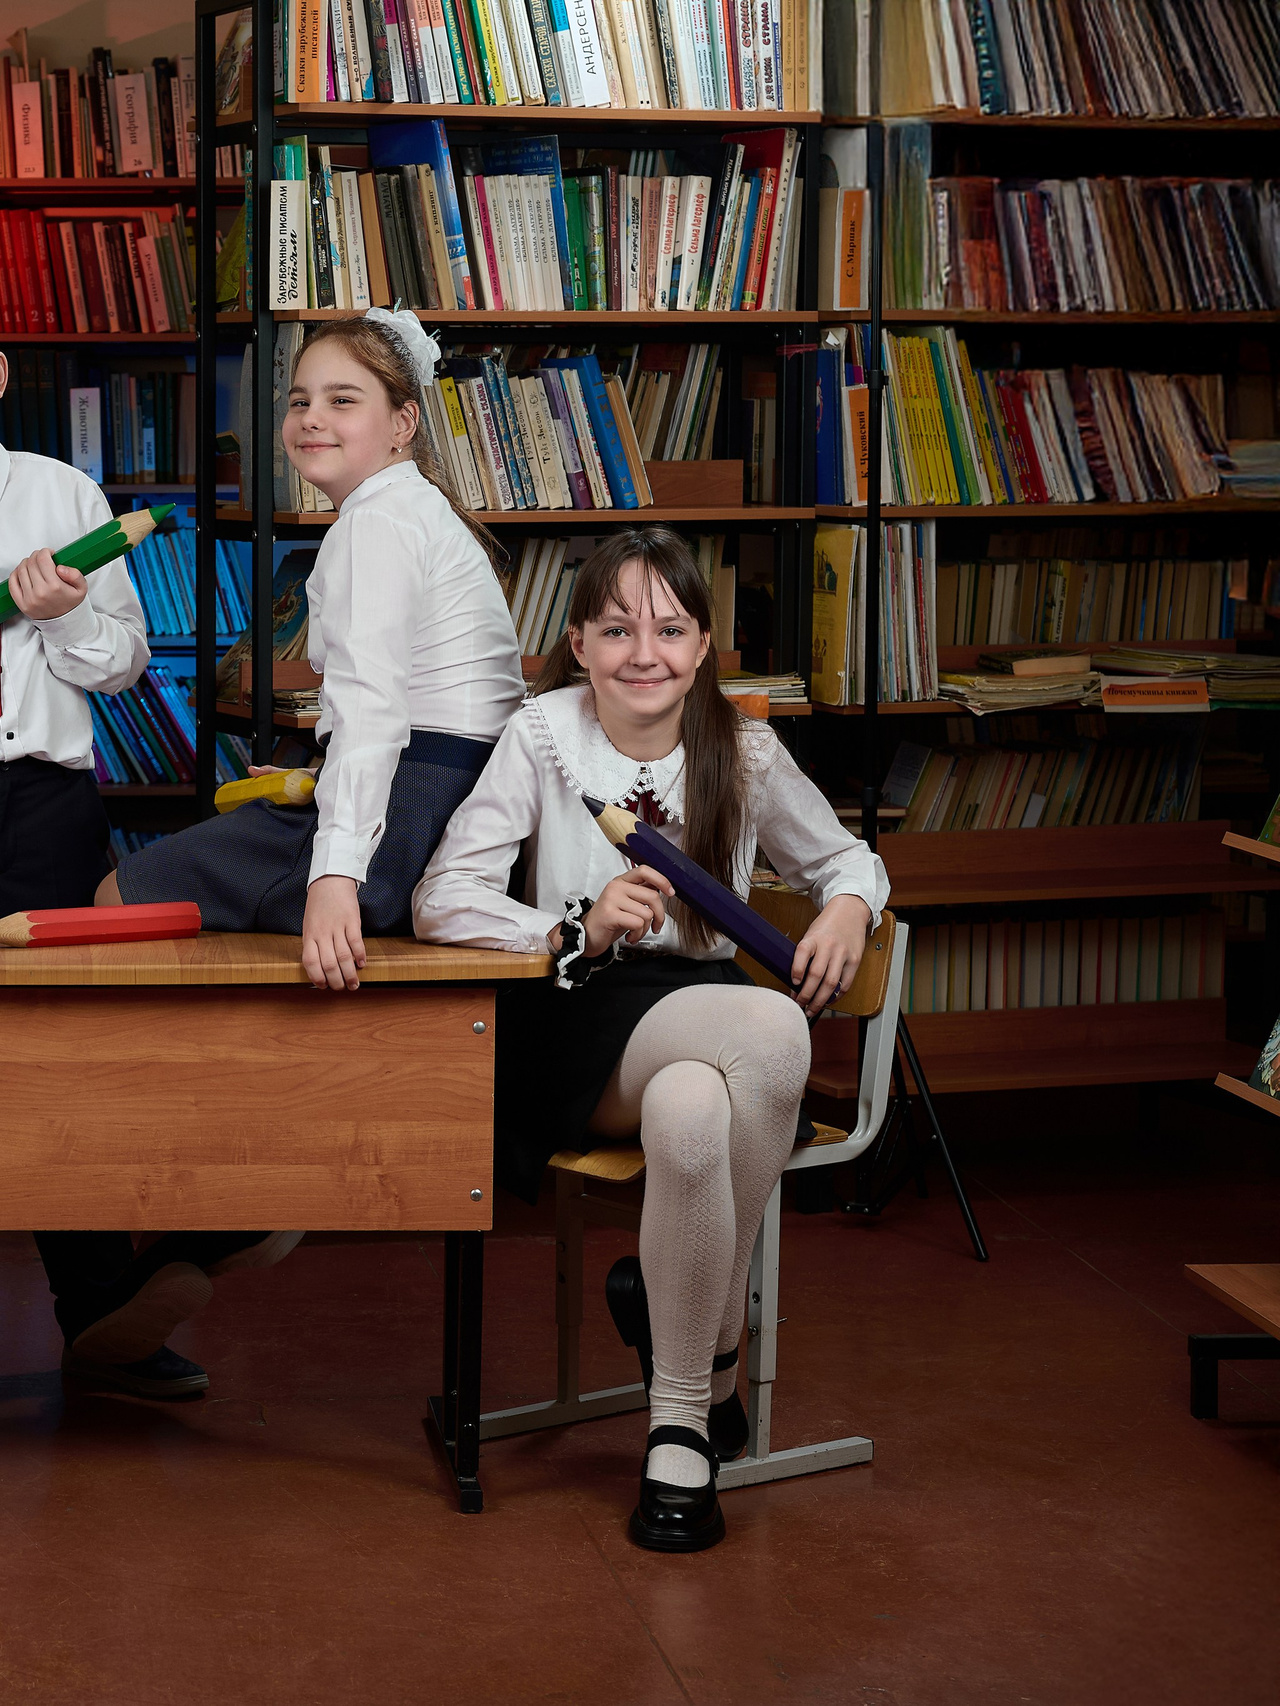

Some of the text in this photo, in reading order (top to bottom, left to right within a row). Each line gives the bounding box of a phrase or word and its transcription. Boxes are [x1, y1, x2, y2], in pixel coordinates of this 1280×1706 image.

[310, 10, 319, 59] писателей
[334, 9, 344, 44] СКАЗКИ
[348, 15, 359, 65] ВОЛШЕБНЫЙ
[410, 18, 418, 40] СКАЗКЕ
[761, 2, 771, 46] СТРАНА
[296, 57, 306, 93] Сказки
[415, 47, 423, 69] СКАЗКИ
[485, 29, 501, 88] Сказки зарубежных
[535, 26, 557, 88] СКАЗКИ СТАРОЙ
[21, 103, 31, 146] Физика
[125, 86, 139, 145] География
[428, 189, 439, 226] КИПЛИНГ
[661, 193, 678, 255] Сельма Лагерлёф
[688, 193, 706, 254] Сельма Лагерлёф
[277, 185, 288, 304] ЗАРУБЕЖНЫЕ ПИСАТЕЛИ
[497, 234, 505, 262] СЕЛЬМА
[512, 236, 521, 263] СЕЛЬМА
[540, 236, 548, 264] СЕЛЬМА
[846, 220, 857, 278] С. Маршак
[144, 253, 159, 303] Растения
[475, 383, 488, 411] СКАЗКИ
[78, 395, 89, 455] Животные
[856, 410, 869, 465] Чуковский
[1108, 687, 1198, 698] Почемучкины книжки
